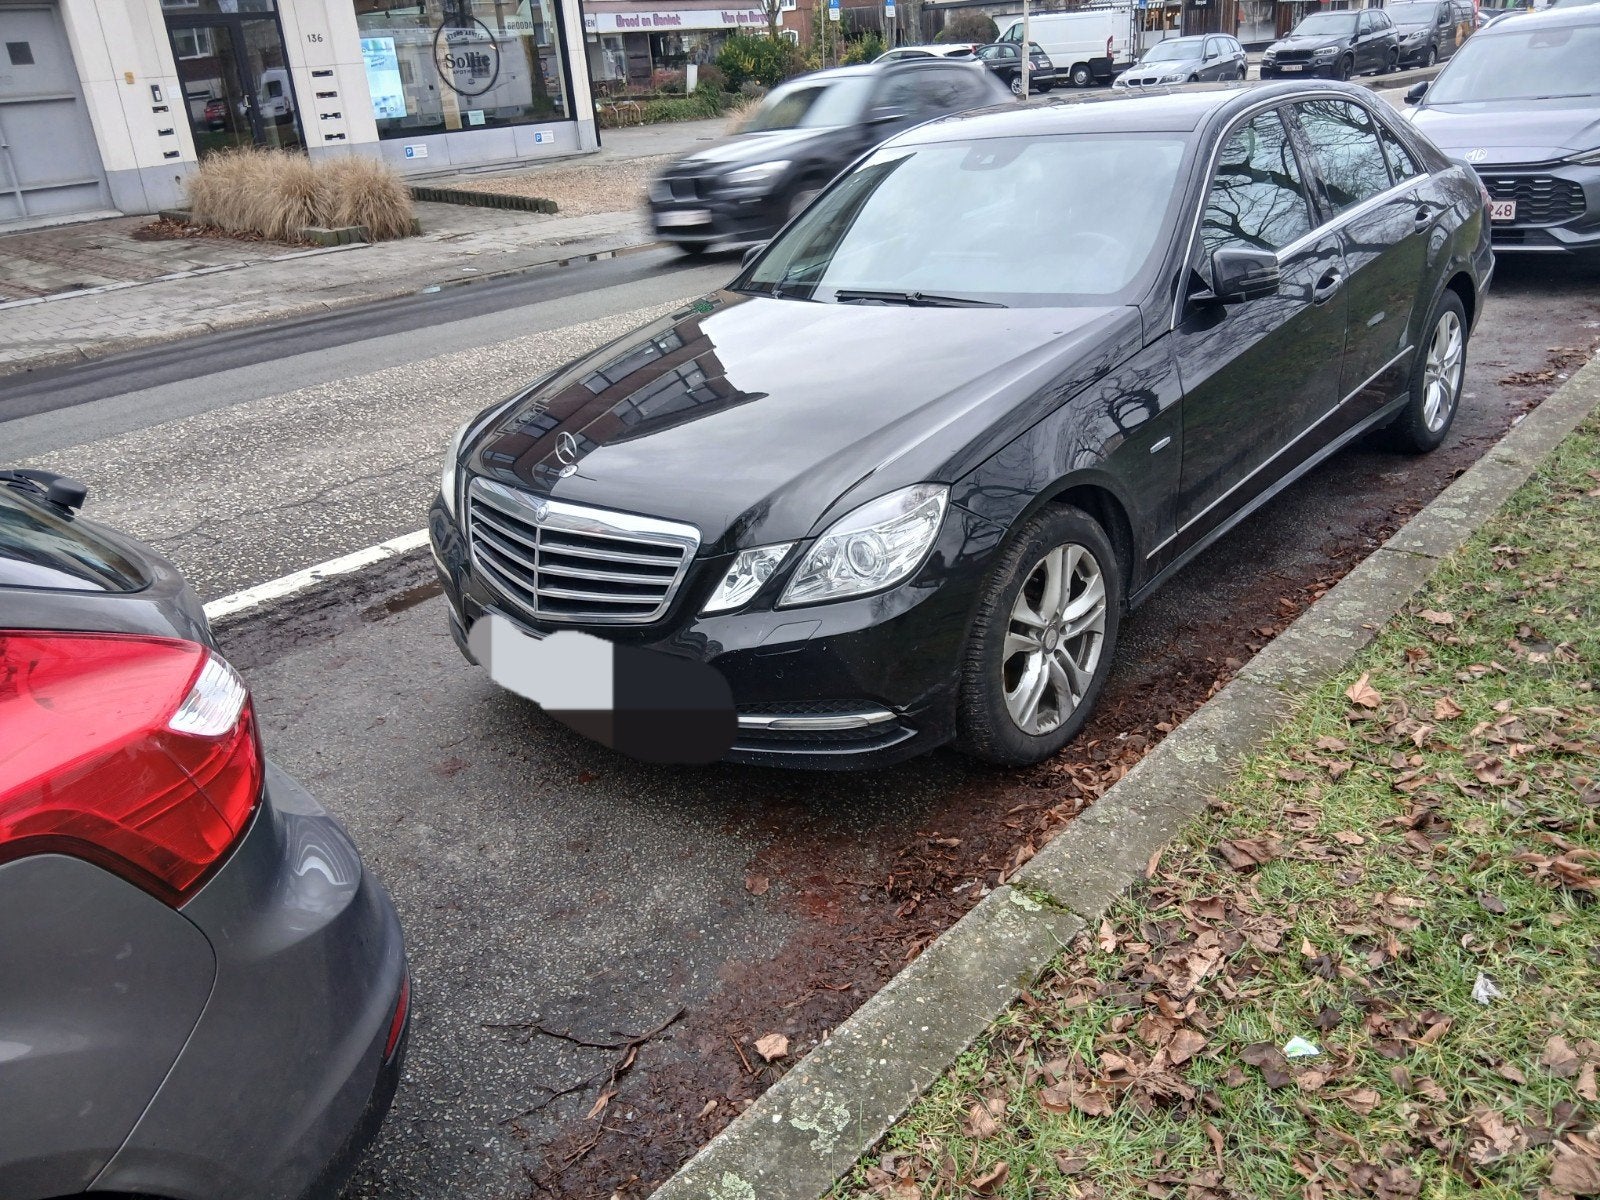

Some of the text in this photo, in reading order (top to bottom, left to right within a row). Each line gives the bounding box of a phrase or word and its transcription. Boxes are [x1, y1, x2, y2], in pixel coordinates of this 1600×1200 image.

[615, 14, 640, 28] Brood
[307, 33, 323, 43] 136
[445, 51, 491, 69] Sollie
